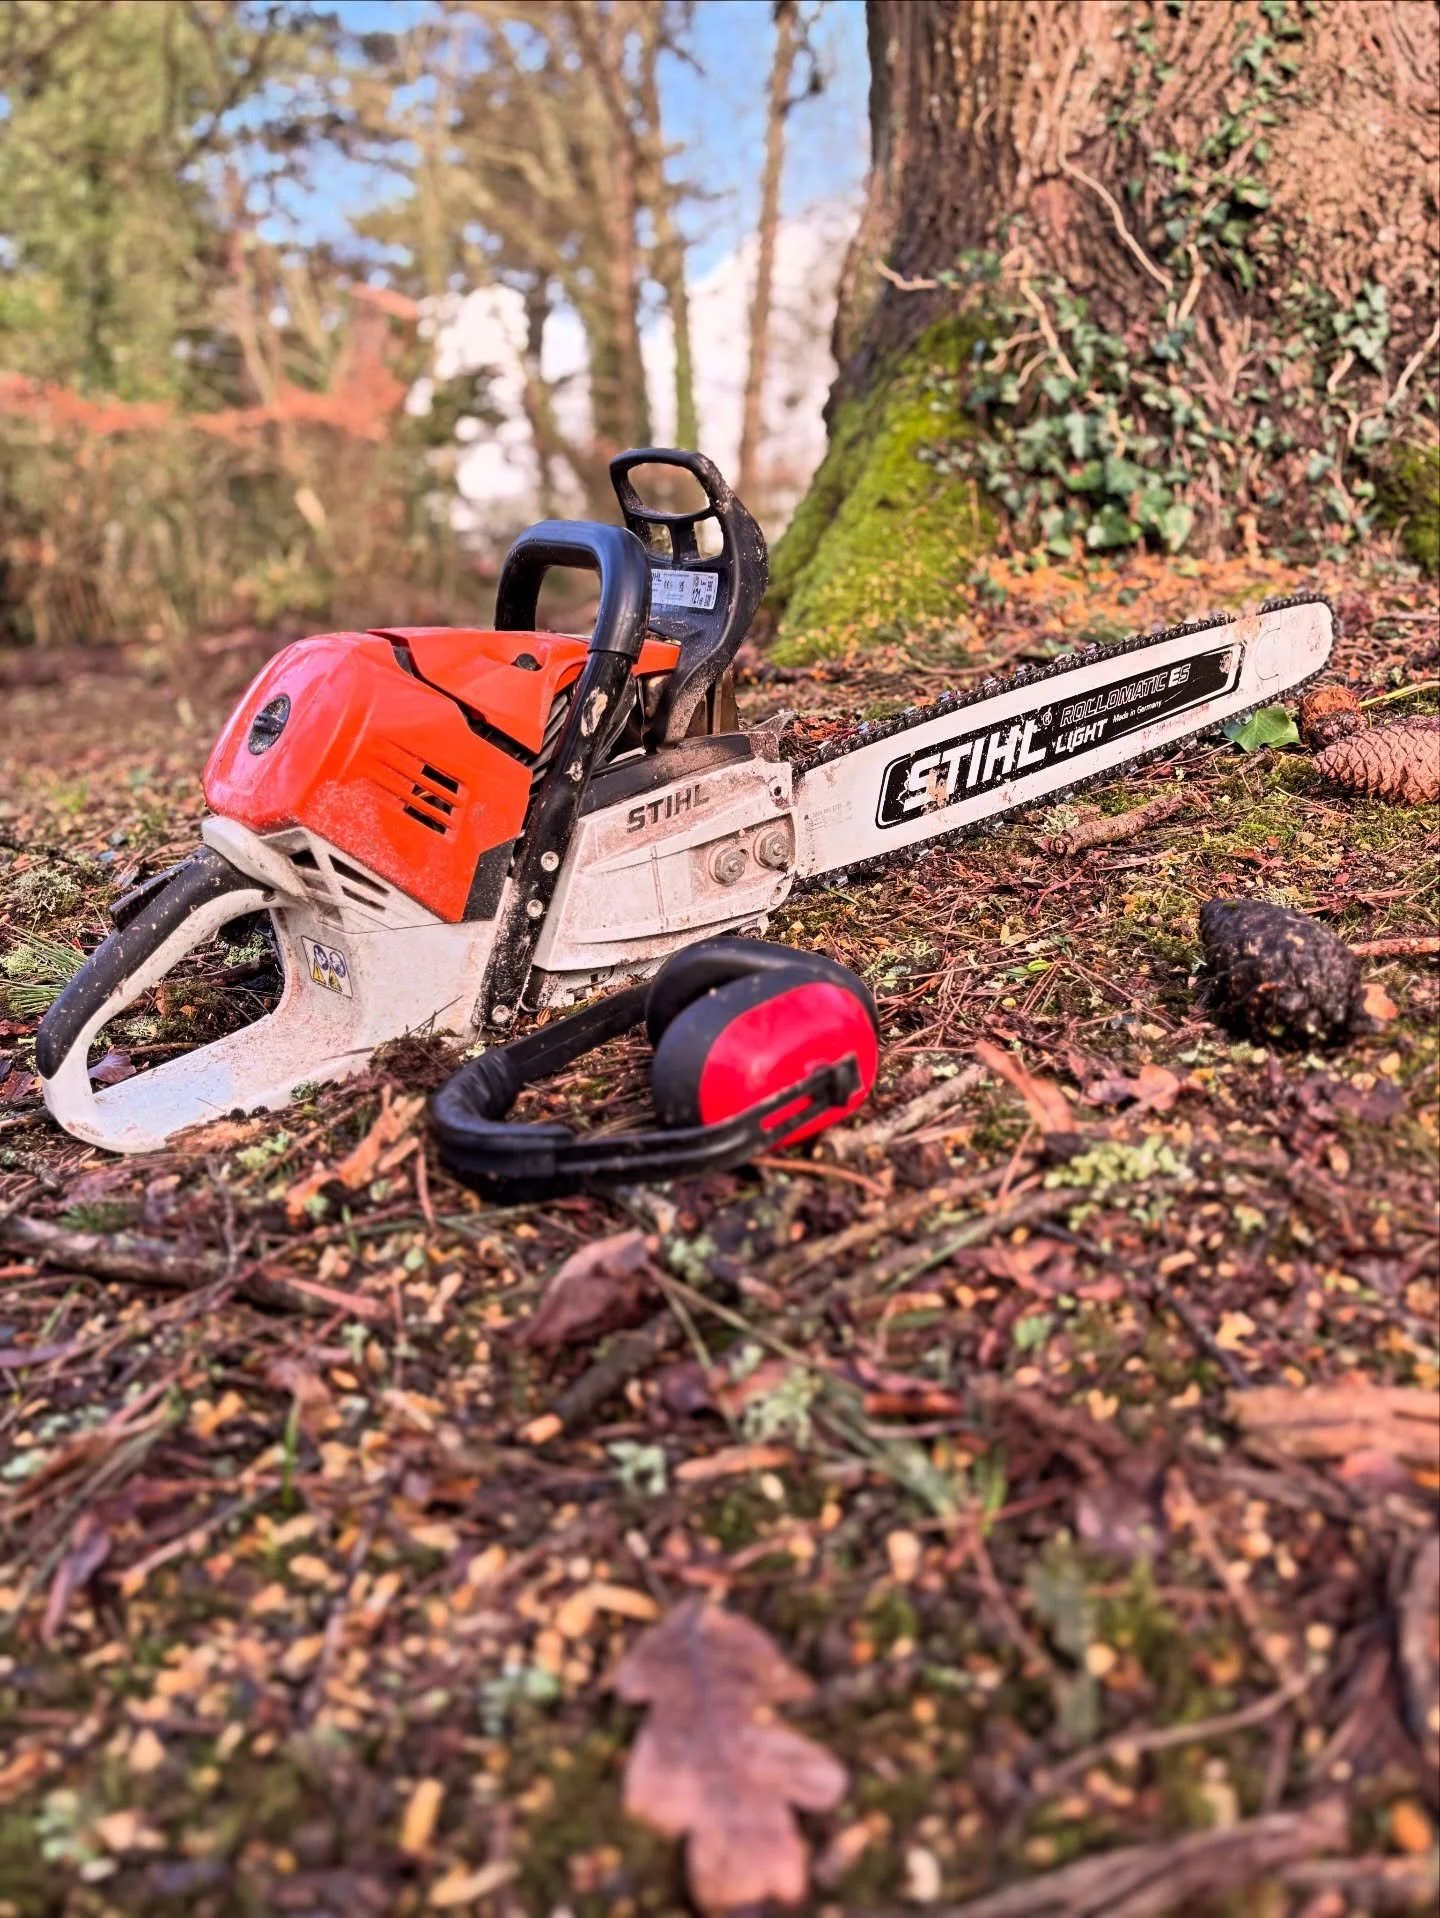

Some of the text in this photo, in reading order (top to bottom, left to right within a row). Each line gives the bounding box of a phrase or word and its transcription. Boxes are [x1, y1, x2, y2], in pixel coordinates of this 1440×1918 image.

[1059, 663, 1192, 728] ROLLOMATIC ES
[1112, 700, 1163, 724] Made in Germany
[1054, 717, 1109, 755] LIGHT
[902, 719, 1048, 813] STIHL
[626, 783, 710, 833] STIHL
